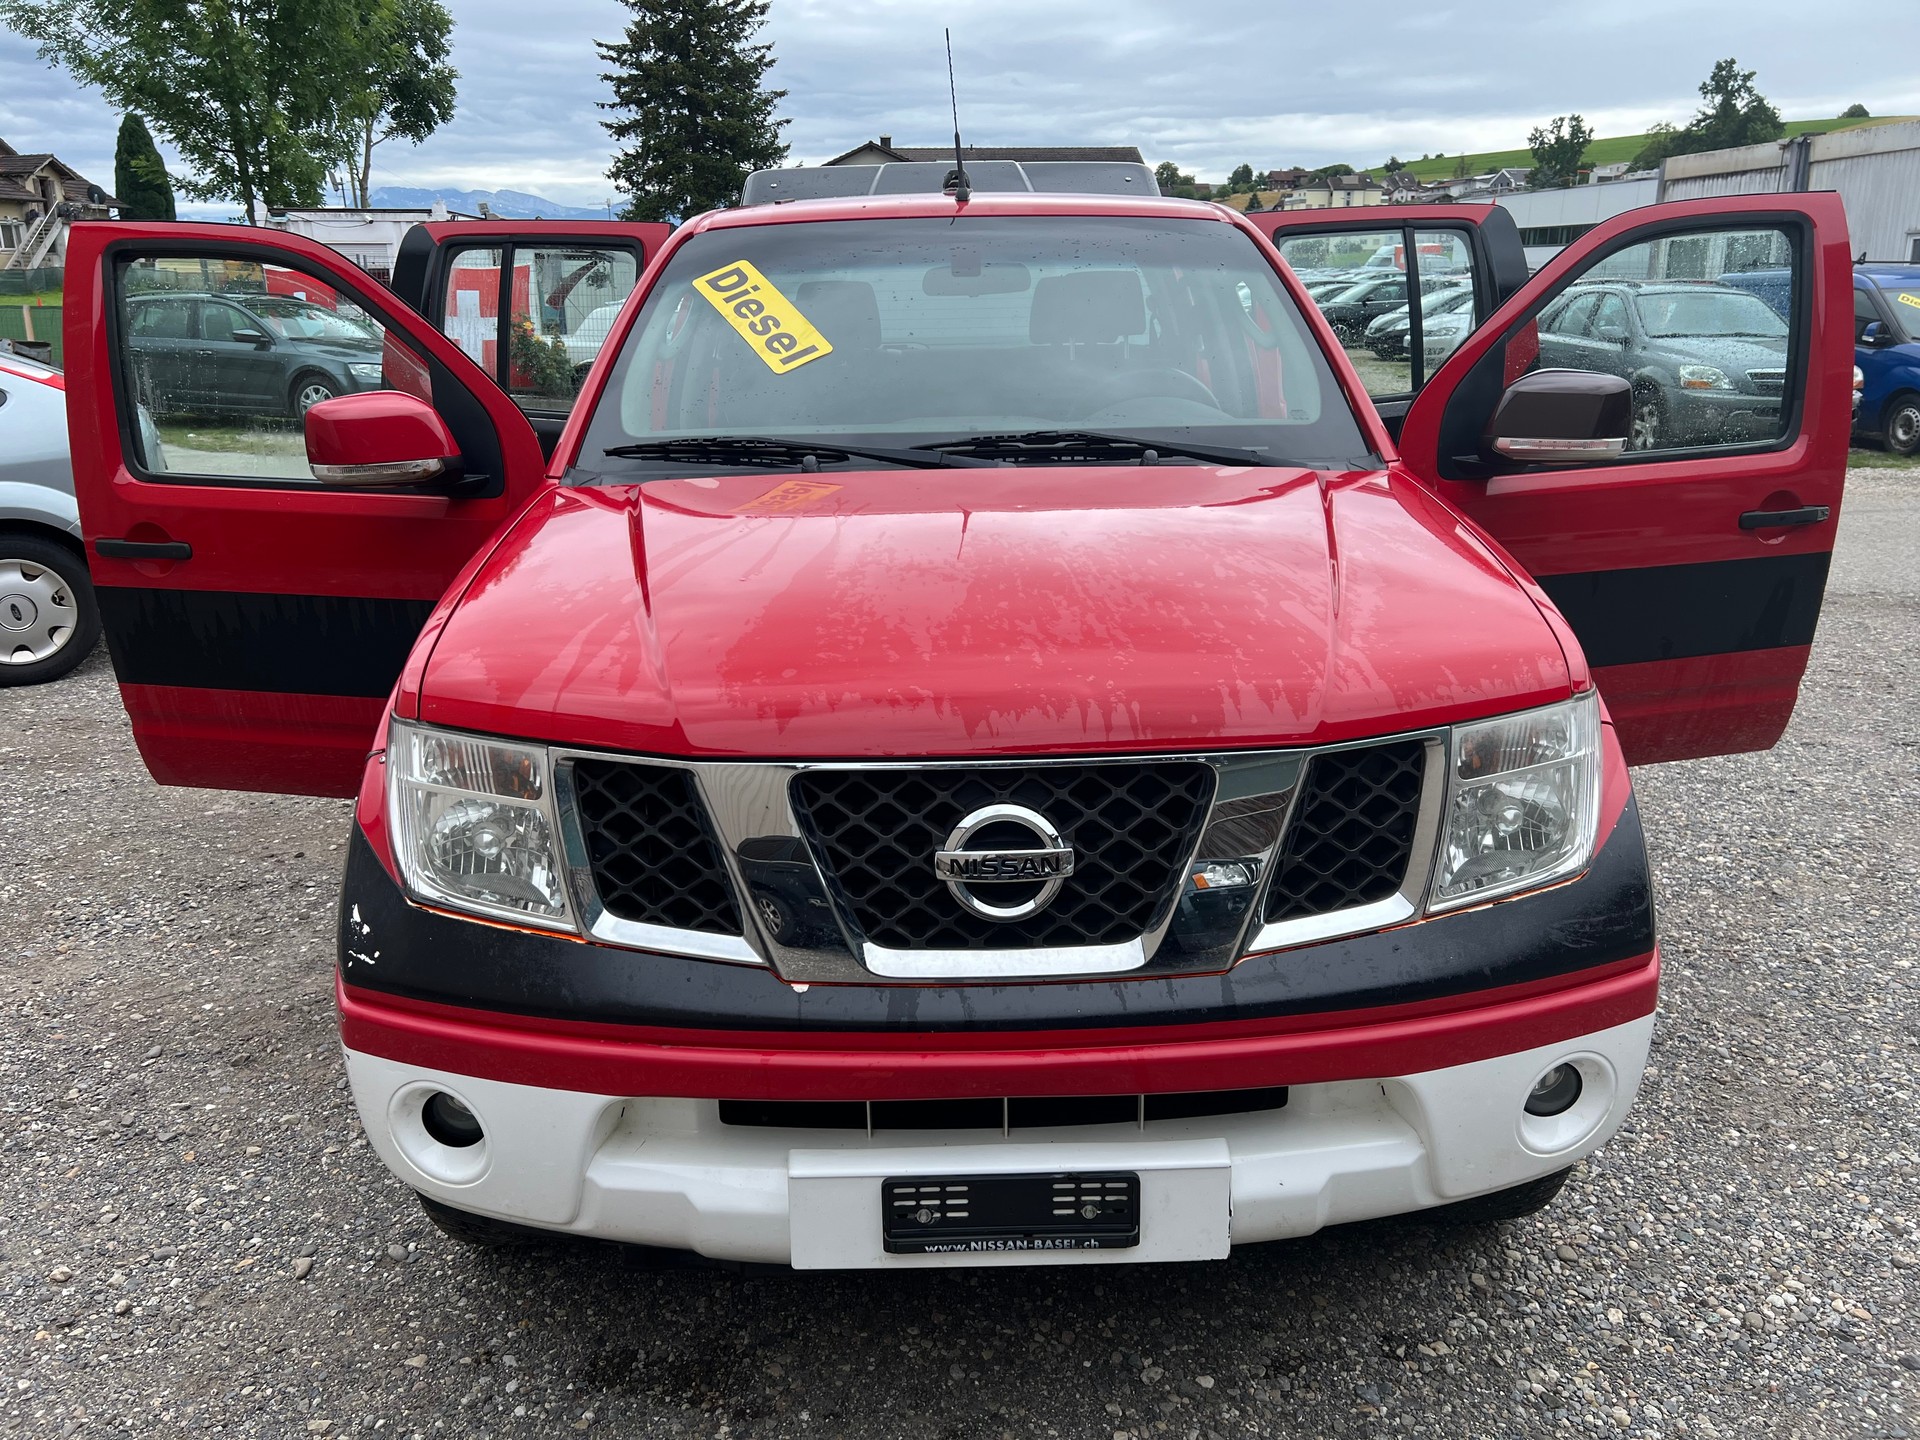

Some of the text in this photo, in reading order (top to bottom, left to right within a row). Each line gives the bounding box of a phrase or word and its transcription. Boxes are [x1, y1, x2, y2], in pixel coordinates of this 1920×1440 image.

[705, 266, 820, 366] Diesel
[950, 856, 1060, 877] NISSAN
[924, 1238, 1100, 1253] www.NISSAN-BASEL.ch
